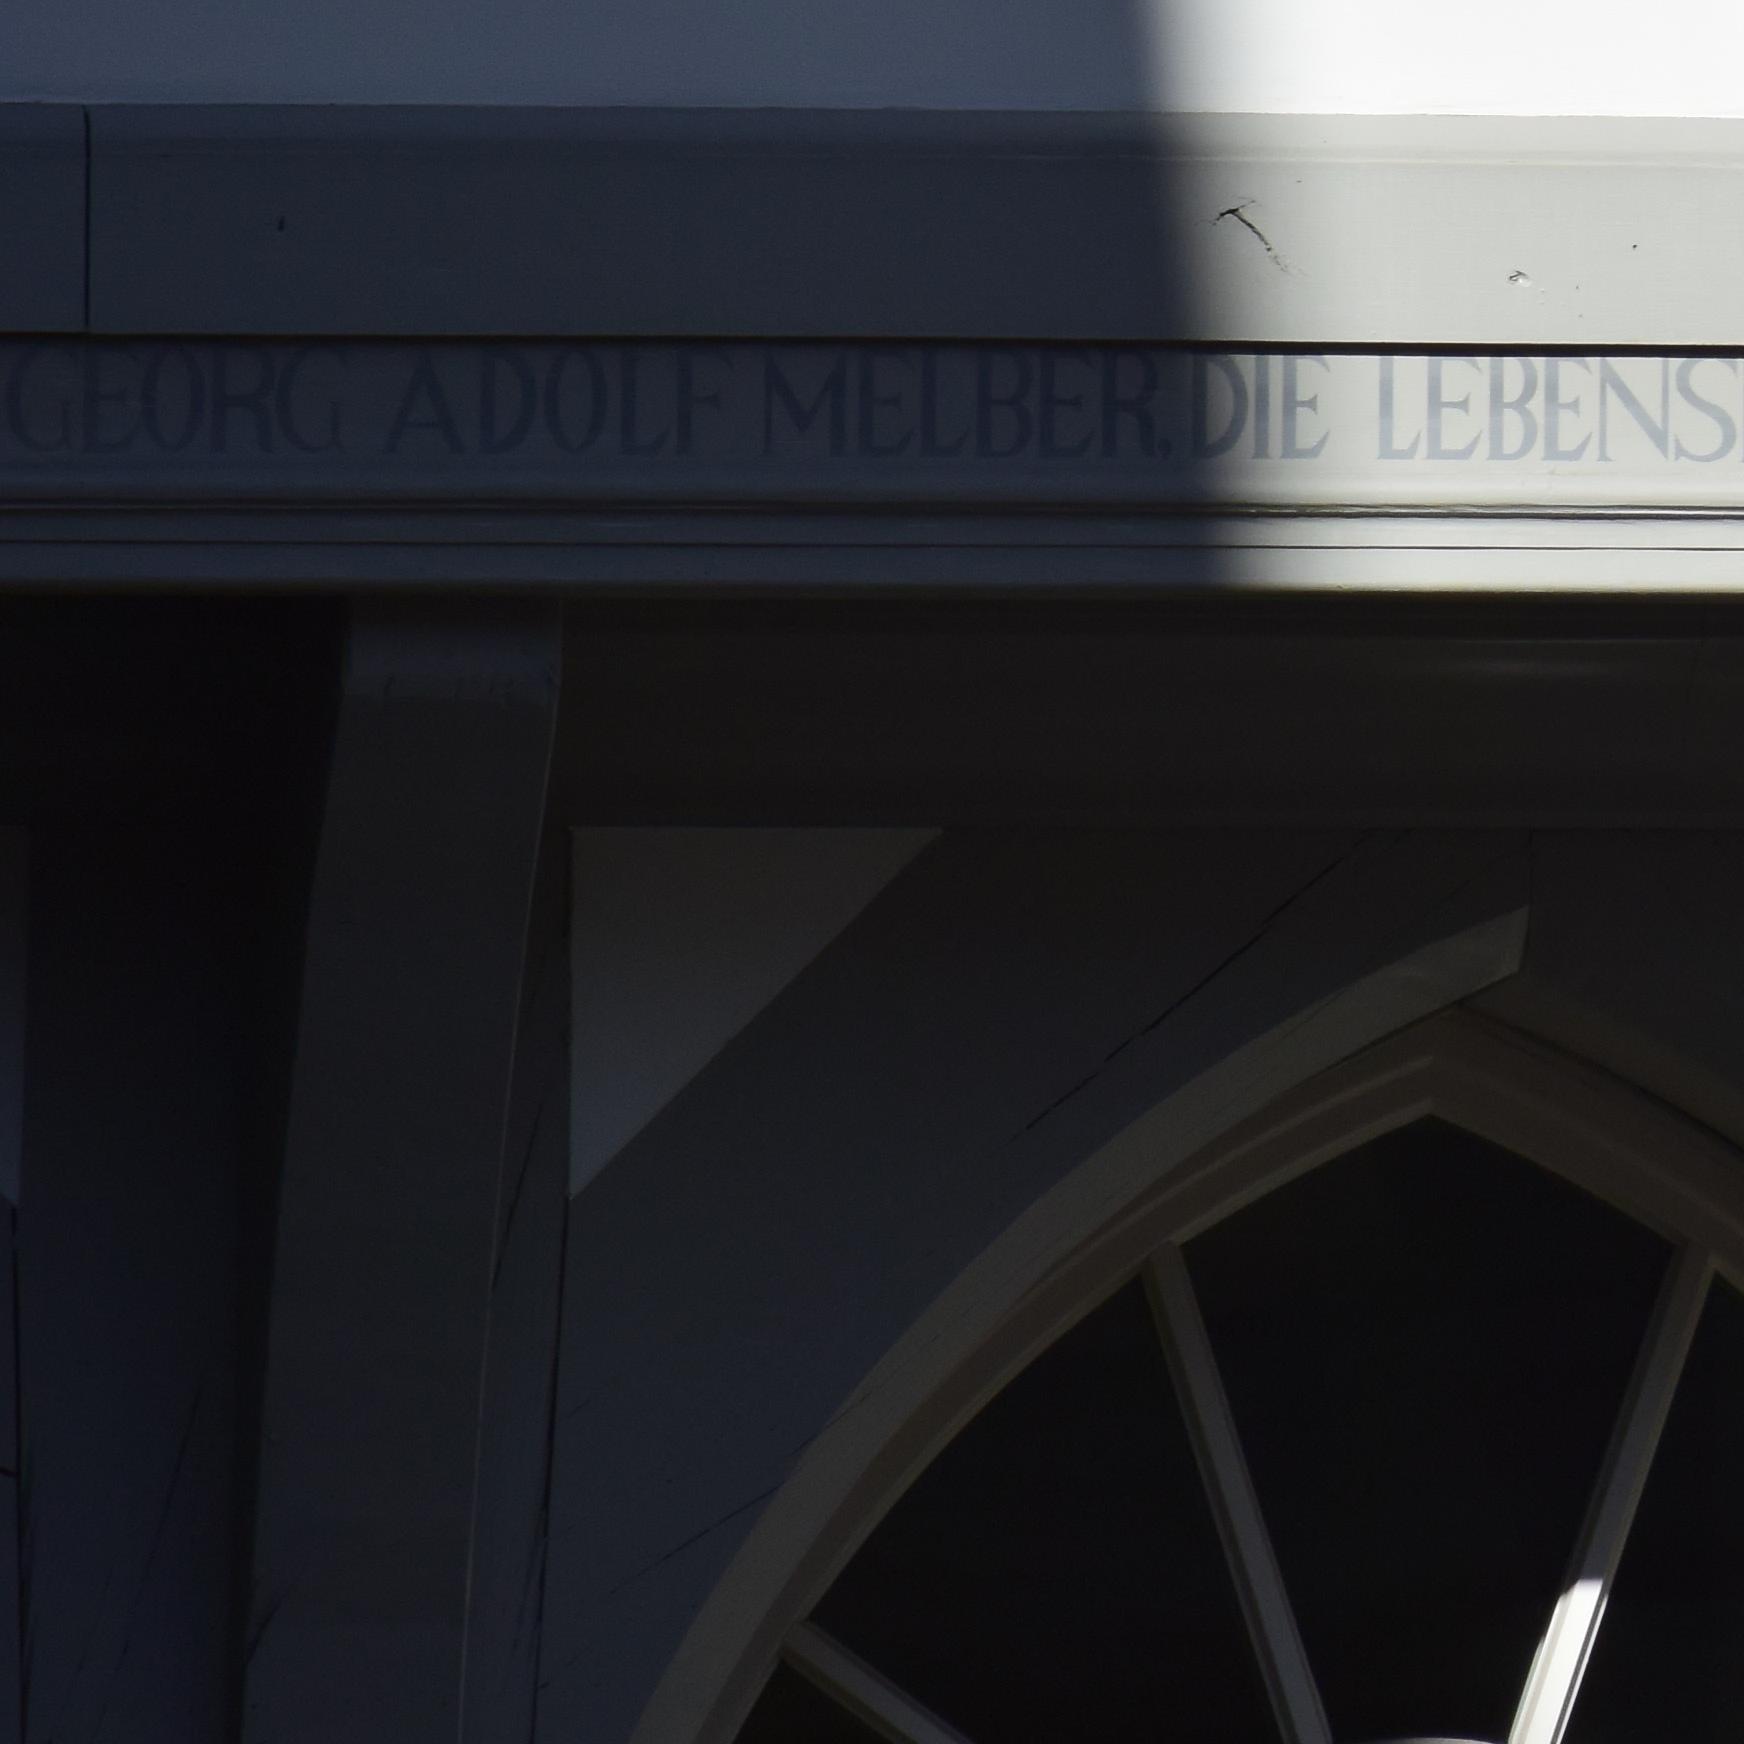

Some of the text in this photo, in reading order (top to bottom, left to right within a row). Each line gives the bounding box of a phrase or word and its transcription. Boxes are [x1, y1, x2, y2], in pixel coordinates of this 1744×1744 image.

[6, 342, 349, 453] GEORG
[382, 344, 735, 455] ADOLF
[1194, 353, 1331, 460] DIE
